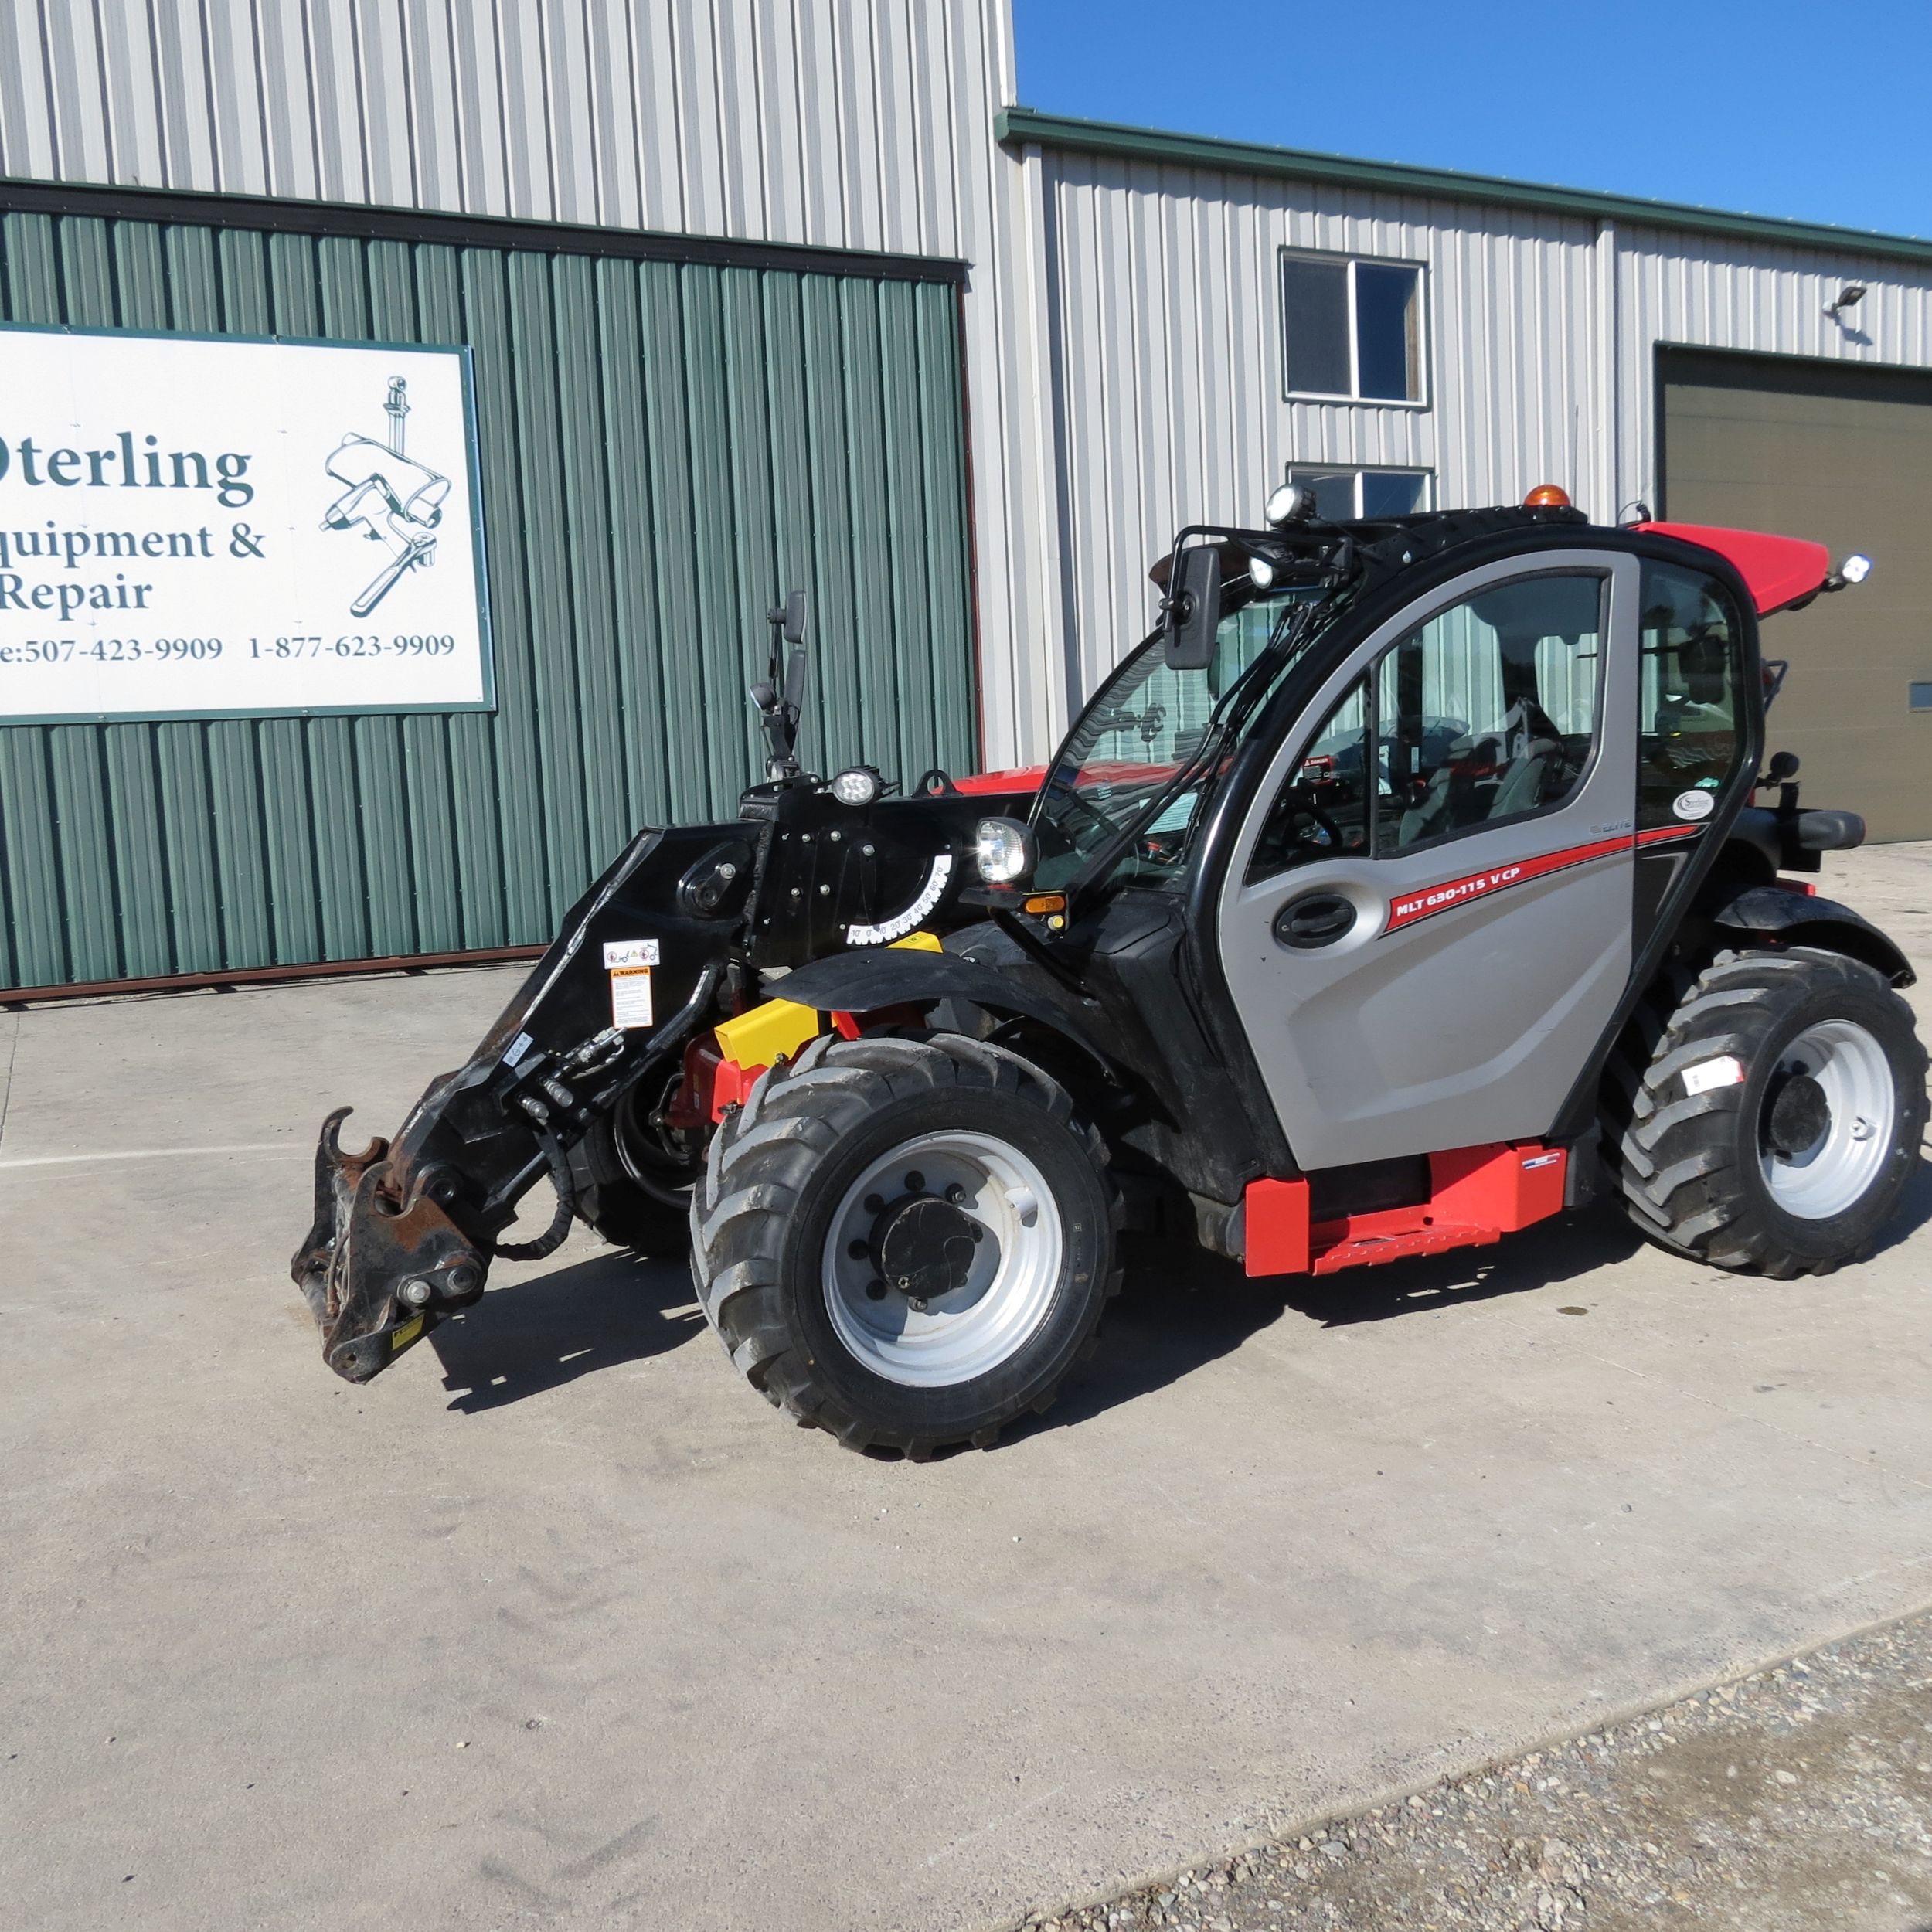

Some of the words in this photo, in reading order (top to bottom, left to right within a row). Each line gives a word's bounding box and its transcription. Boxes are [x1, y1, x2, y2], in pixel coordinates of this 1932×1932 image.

[0, 431, 254, 509] terling
[229, 522, 265, 559] &
[0, 573, 153, 621] Repair
[250, 635, 455, 659] 1-877-623-9909
[1396, 899, 1424, 917] MLT
[1427, 879, 1485, 906] 630-115
[1490, 873, 1501, 884] V
[1502, 867, 1520, 881] CP
